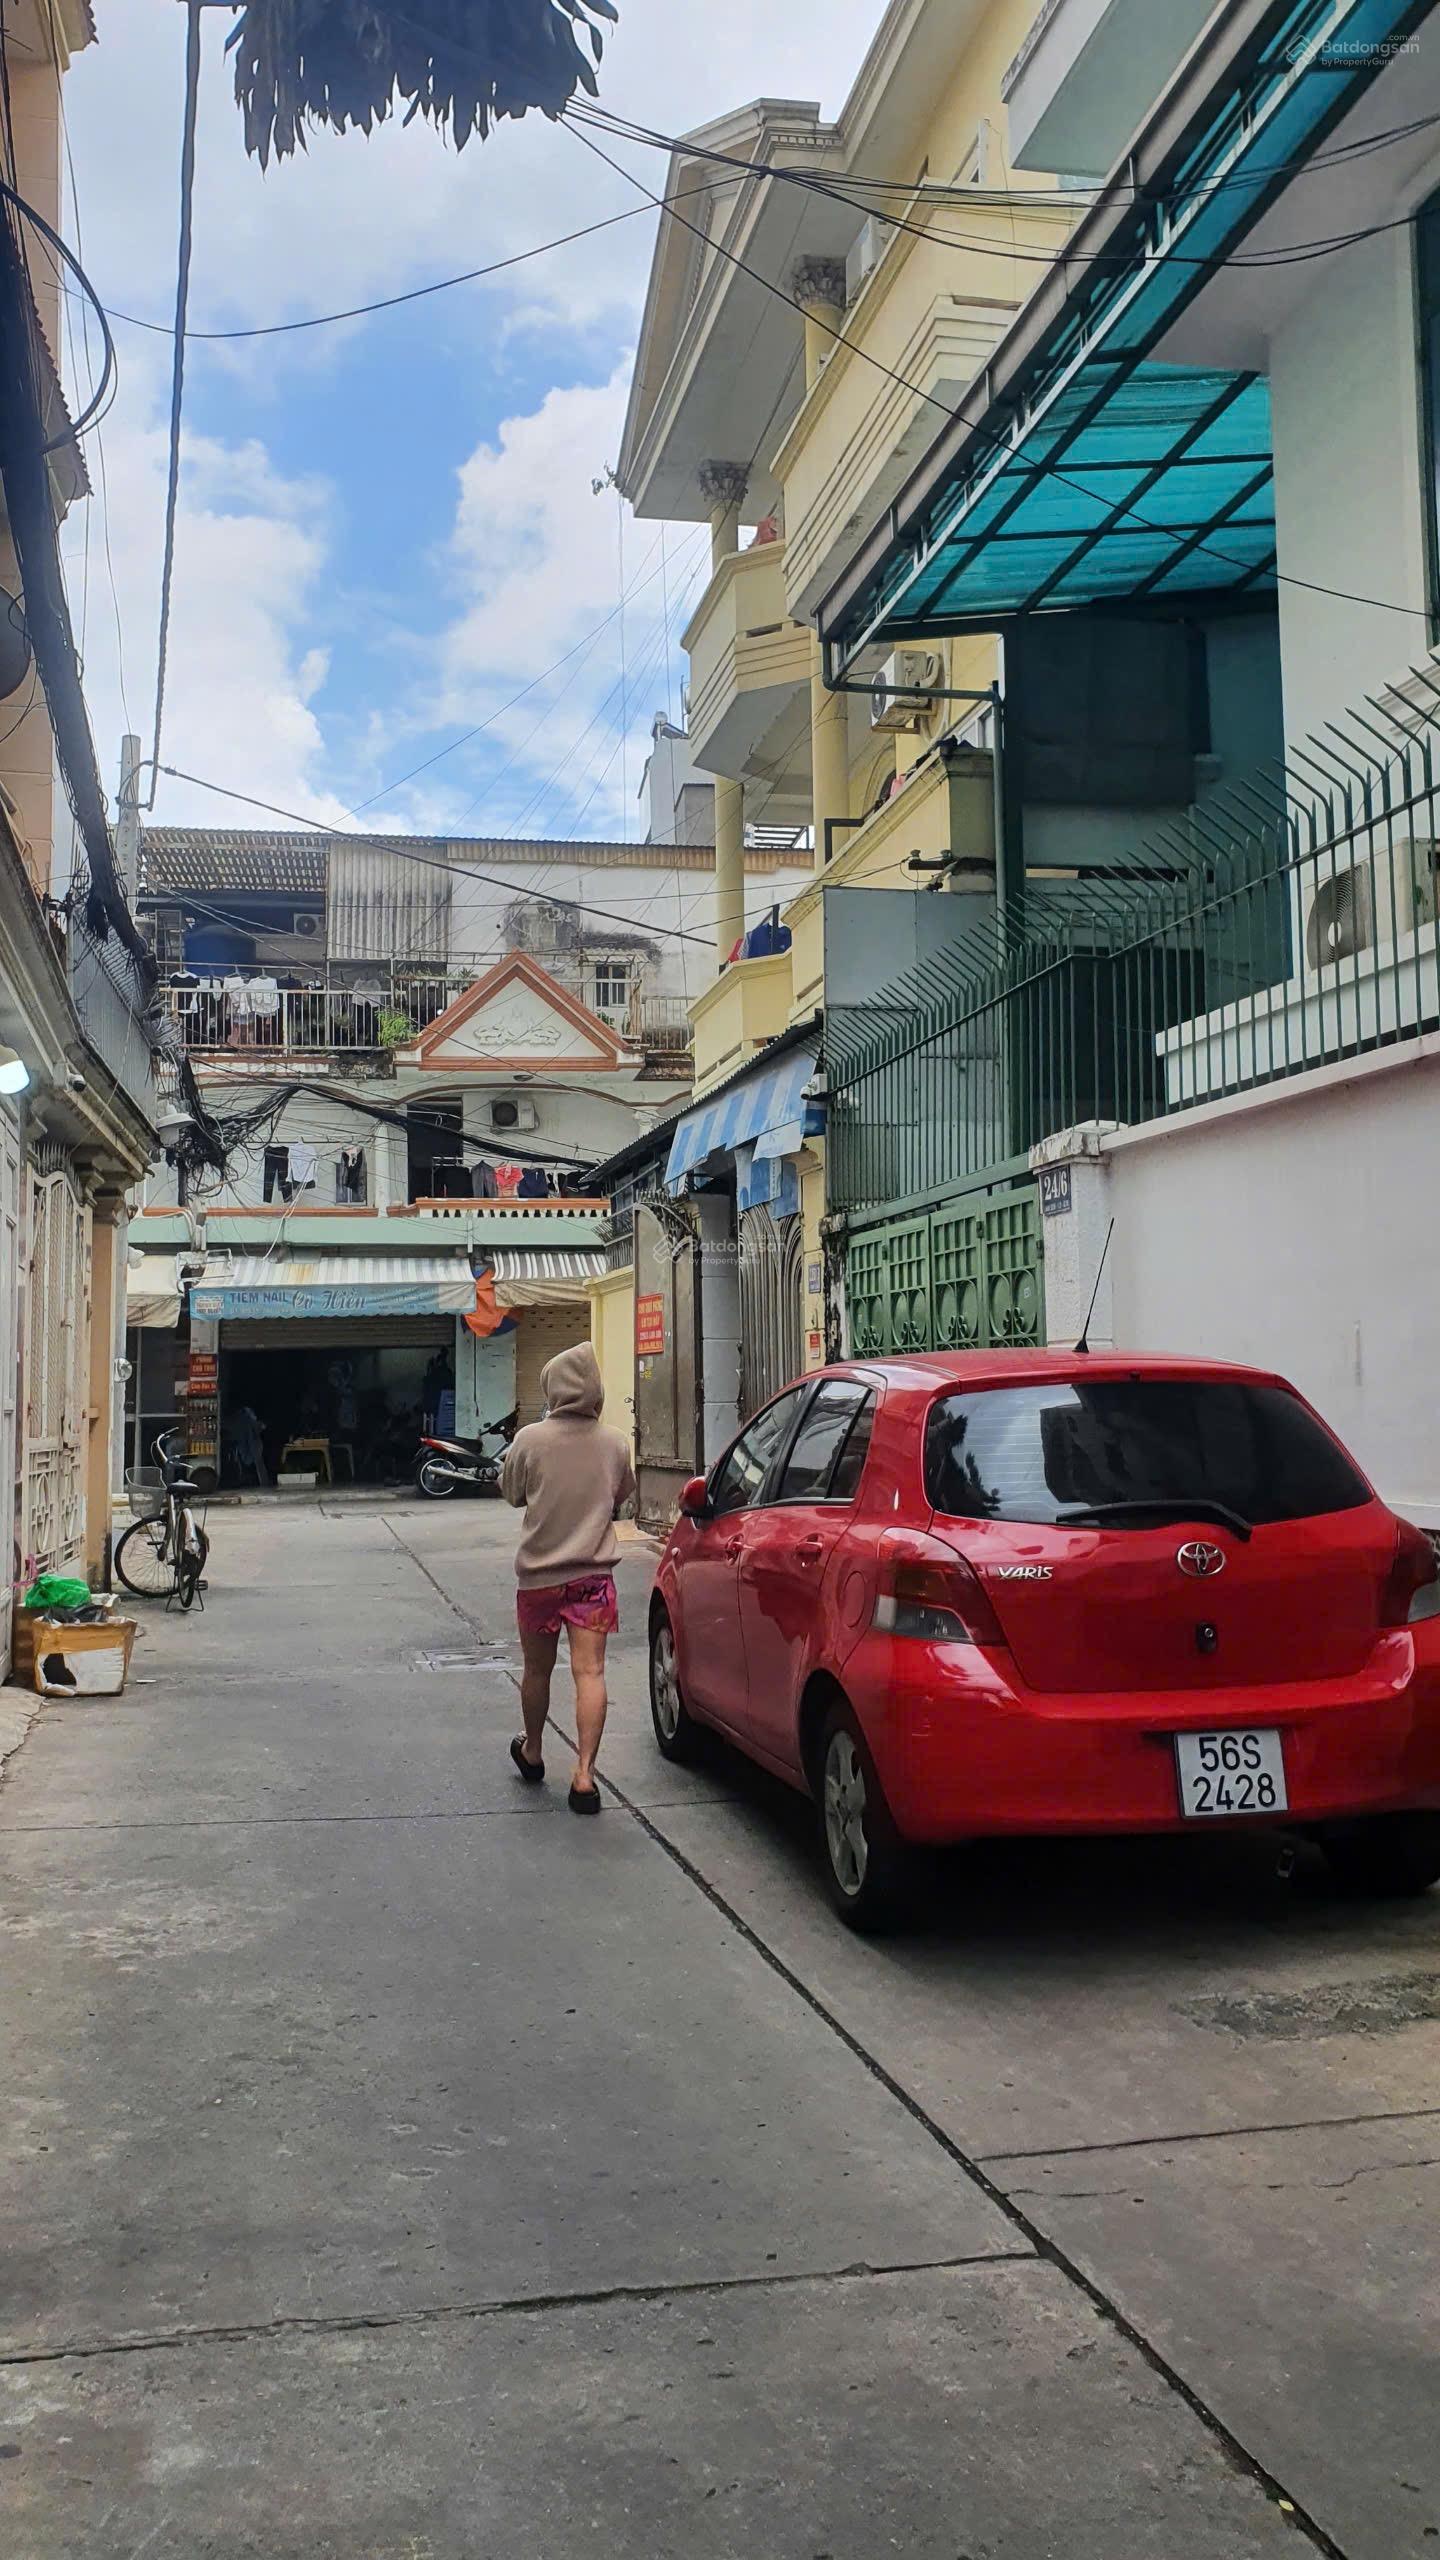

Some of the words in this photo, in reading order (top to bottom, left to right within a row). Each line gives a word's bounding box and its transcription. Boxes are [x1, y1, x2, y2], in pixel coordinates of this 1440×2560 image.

[263, 1291, 289, 1304] NAIL
[1199, 1734, 1261, 1772] 56S
[1192, 1772, 1276, 1813] 2428
